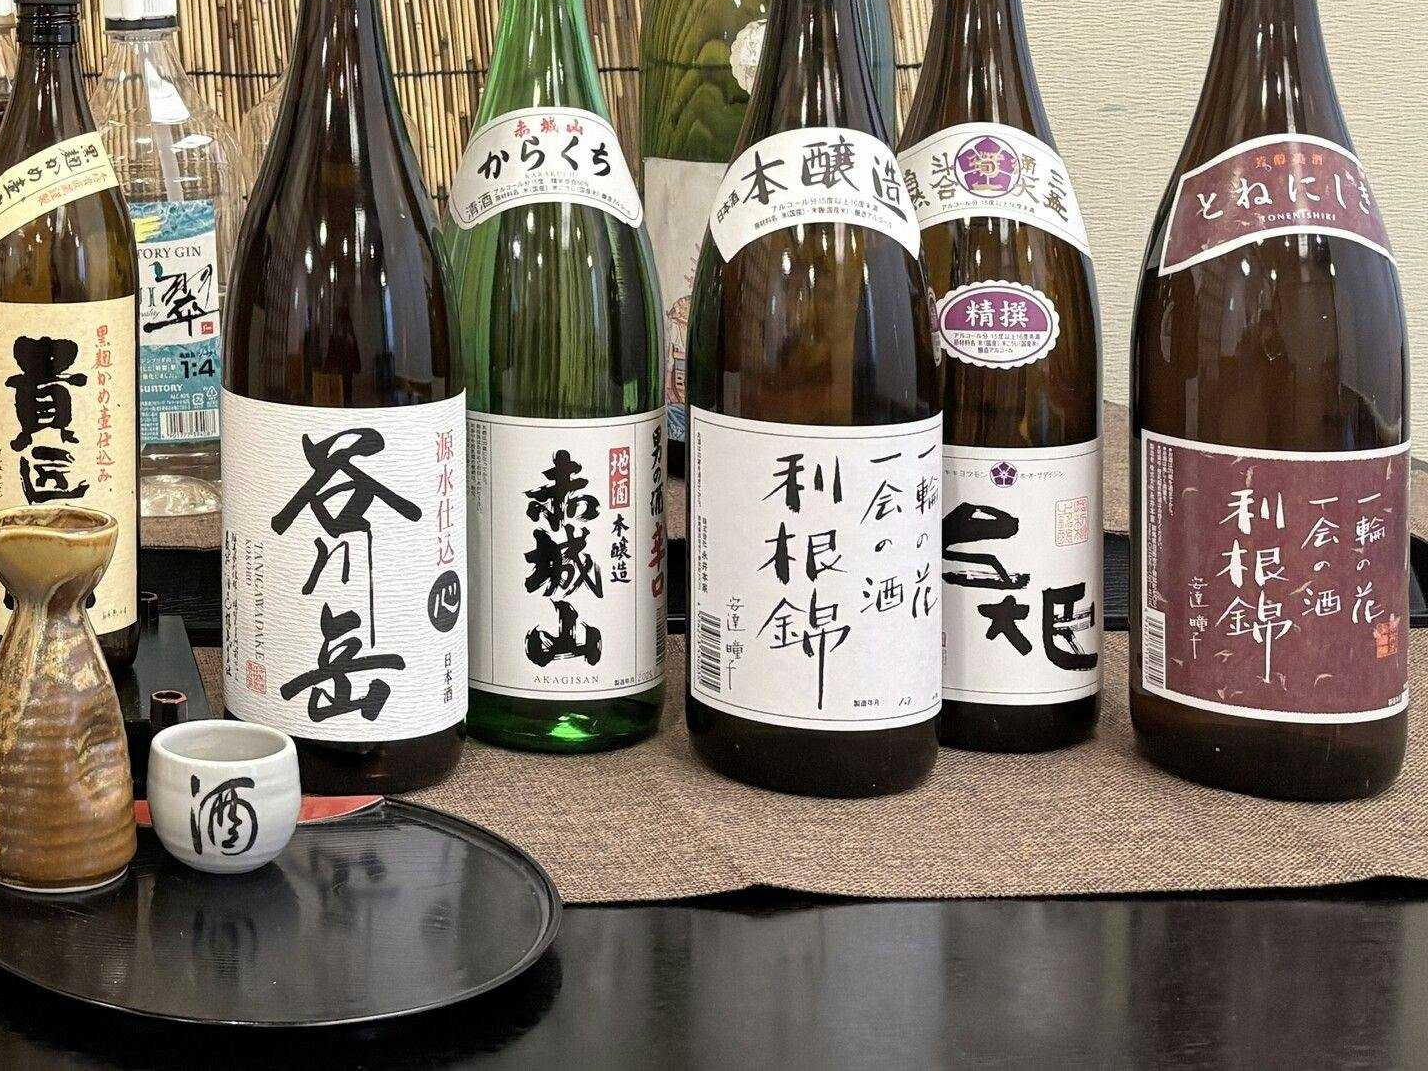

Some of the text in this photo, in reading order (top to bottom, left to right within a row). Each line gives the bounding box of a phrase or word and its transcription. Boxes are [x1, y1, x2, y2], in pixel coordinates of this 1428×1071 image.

[477, 135, 612, 180] からくち
[513, 116, 584, 138] 赤城山
[465, 192, 494, 221] 清酒
[716, 189, 740, 225] 日本酒
[740, 134, 909, 223] 本醸造
[1196, 172, 1371, 221] とねにしき
[174, 246, 202, 258] GIN
[964, 298, 1030, 329] 精撰
[180, 359, 215, 379] 1:4
[435, 429, 455, 567] 源水仕込
[610, 449, 630, 506] 地酒
[523, 449, 604, 668] 赤城山
[610, 513, 632, 584] 本醸造
[860, 452, 905, 614] 一会の酒
[911, 444, 940, 620] 一輪の花
[1301, 496, 1341, 618] 一会の酒
[1351, 492, 1386, 624] 一輪の花
[254, 542, 265, 661] TANIGAWADAKE
[271, 428, 423, 723] 谷川岳
[756, 453, 852, 711] 利根錦
[1215, 488, 1294, 684] 利根錦
[443, 652, 453, 705] 日本酒
[533, 675, 599, 685] AKAGISAN
[189, 774, 259, 857] 酒
